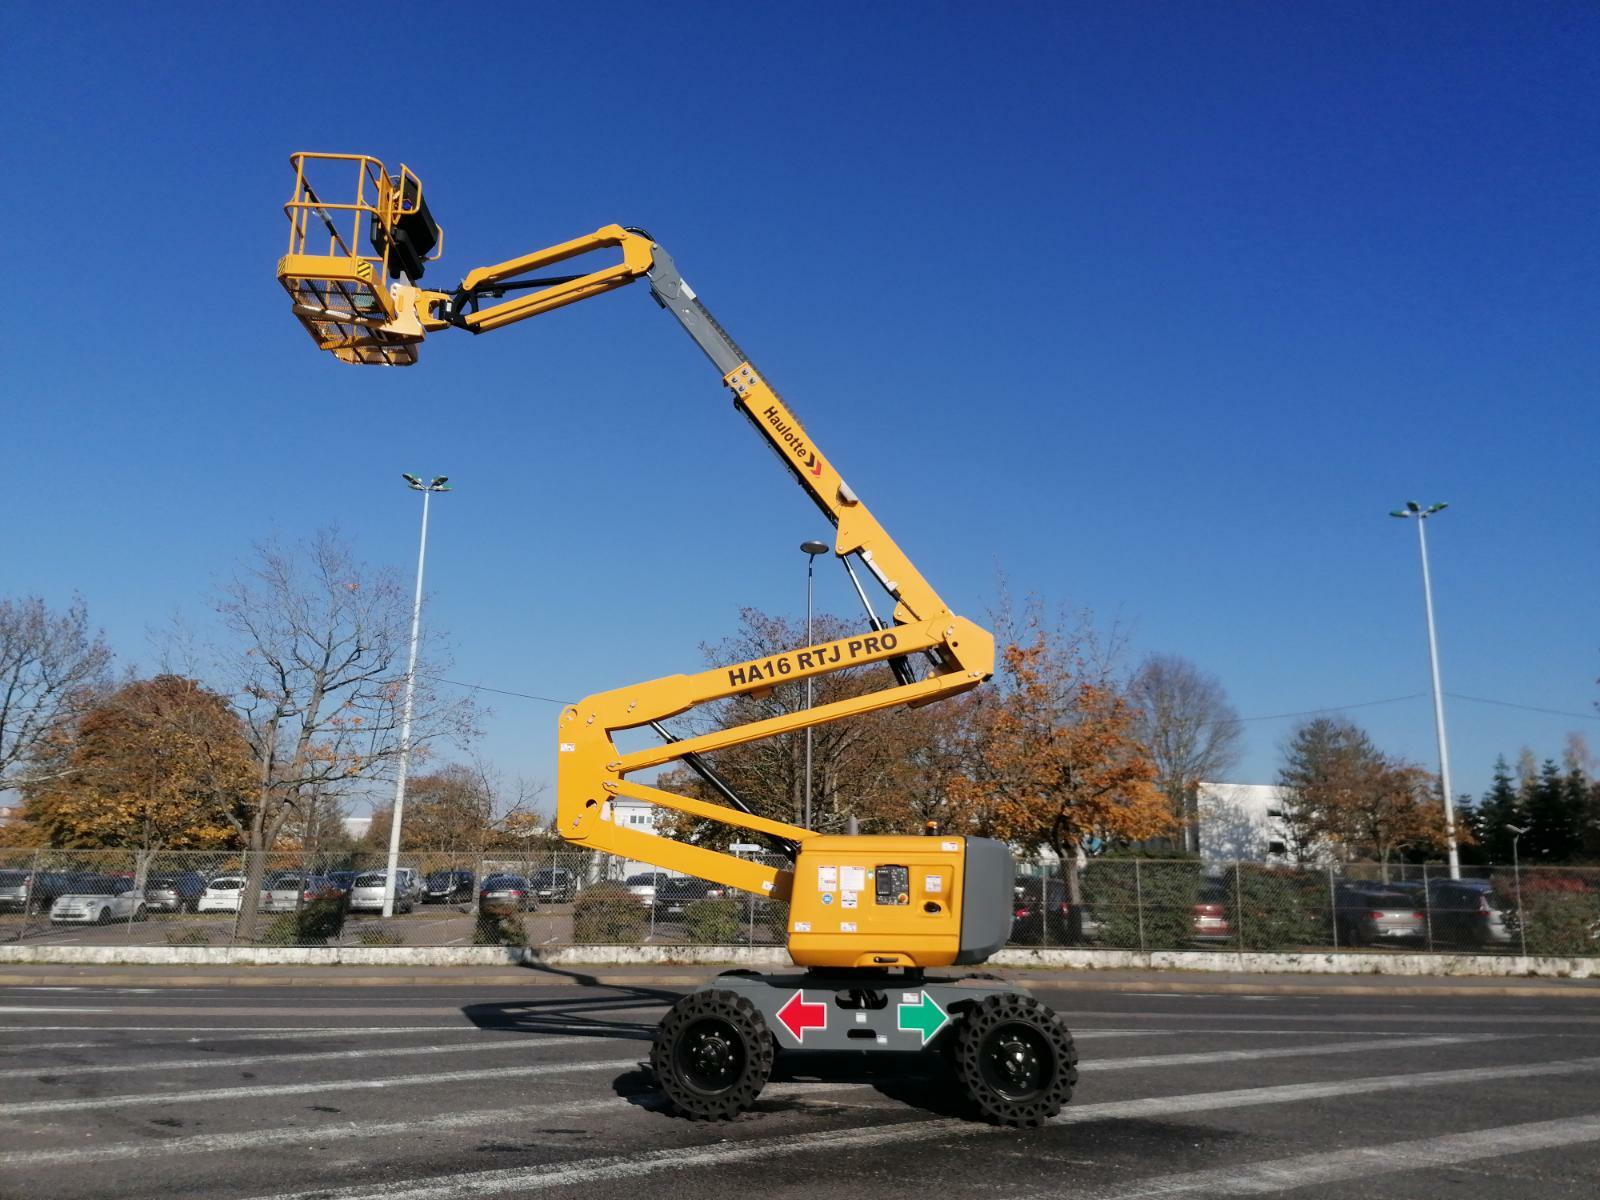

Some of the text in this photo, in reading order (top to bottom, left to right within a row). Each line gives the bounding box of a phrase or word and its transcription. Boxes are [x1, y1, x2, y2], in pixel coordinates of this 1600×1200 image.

[763, 406, 807, 458] Haulotte
[728, 633, 898, 687] HA16 RTJ PRO
